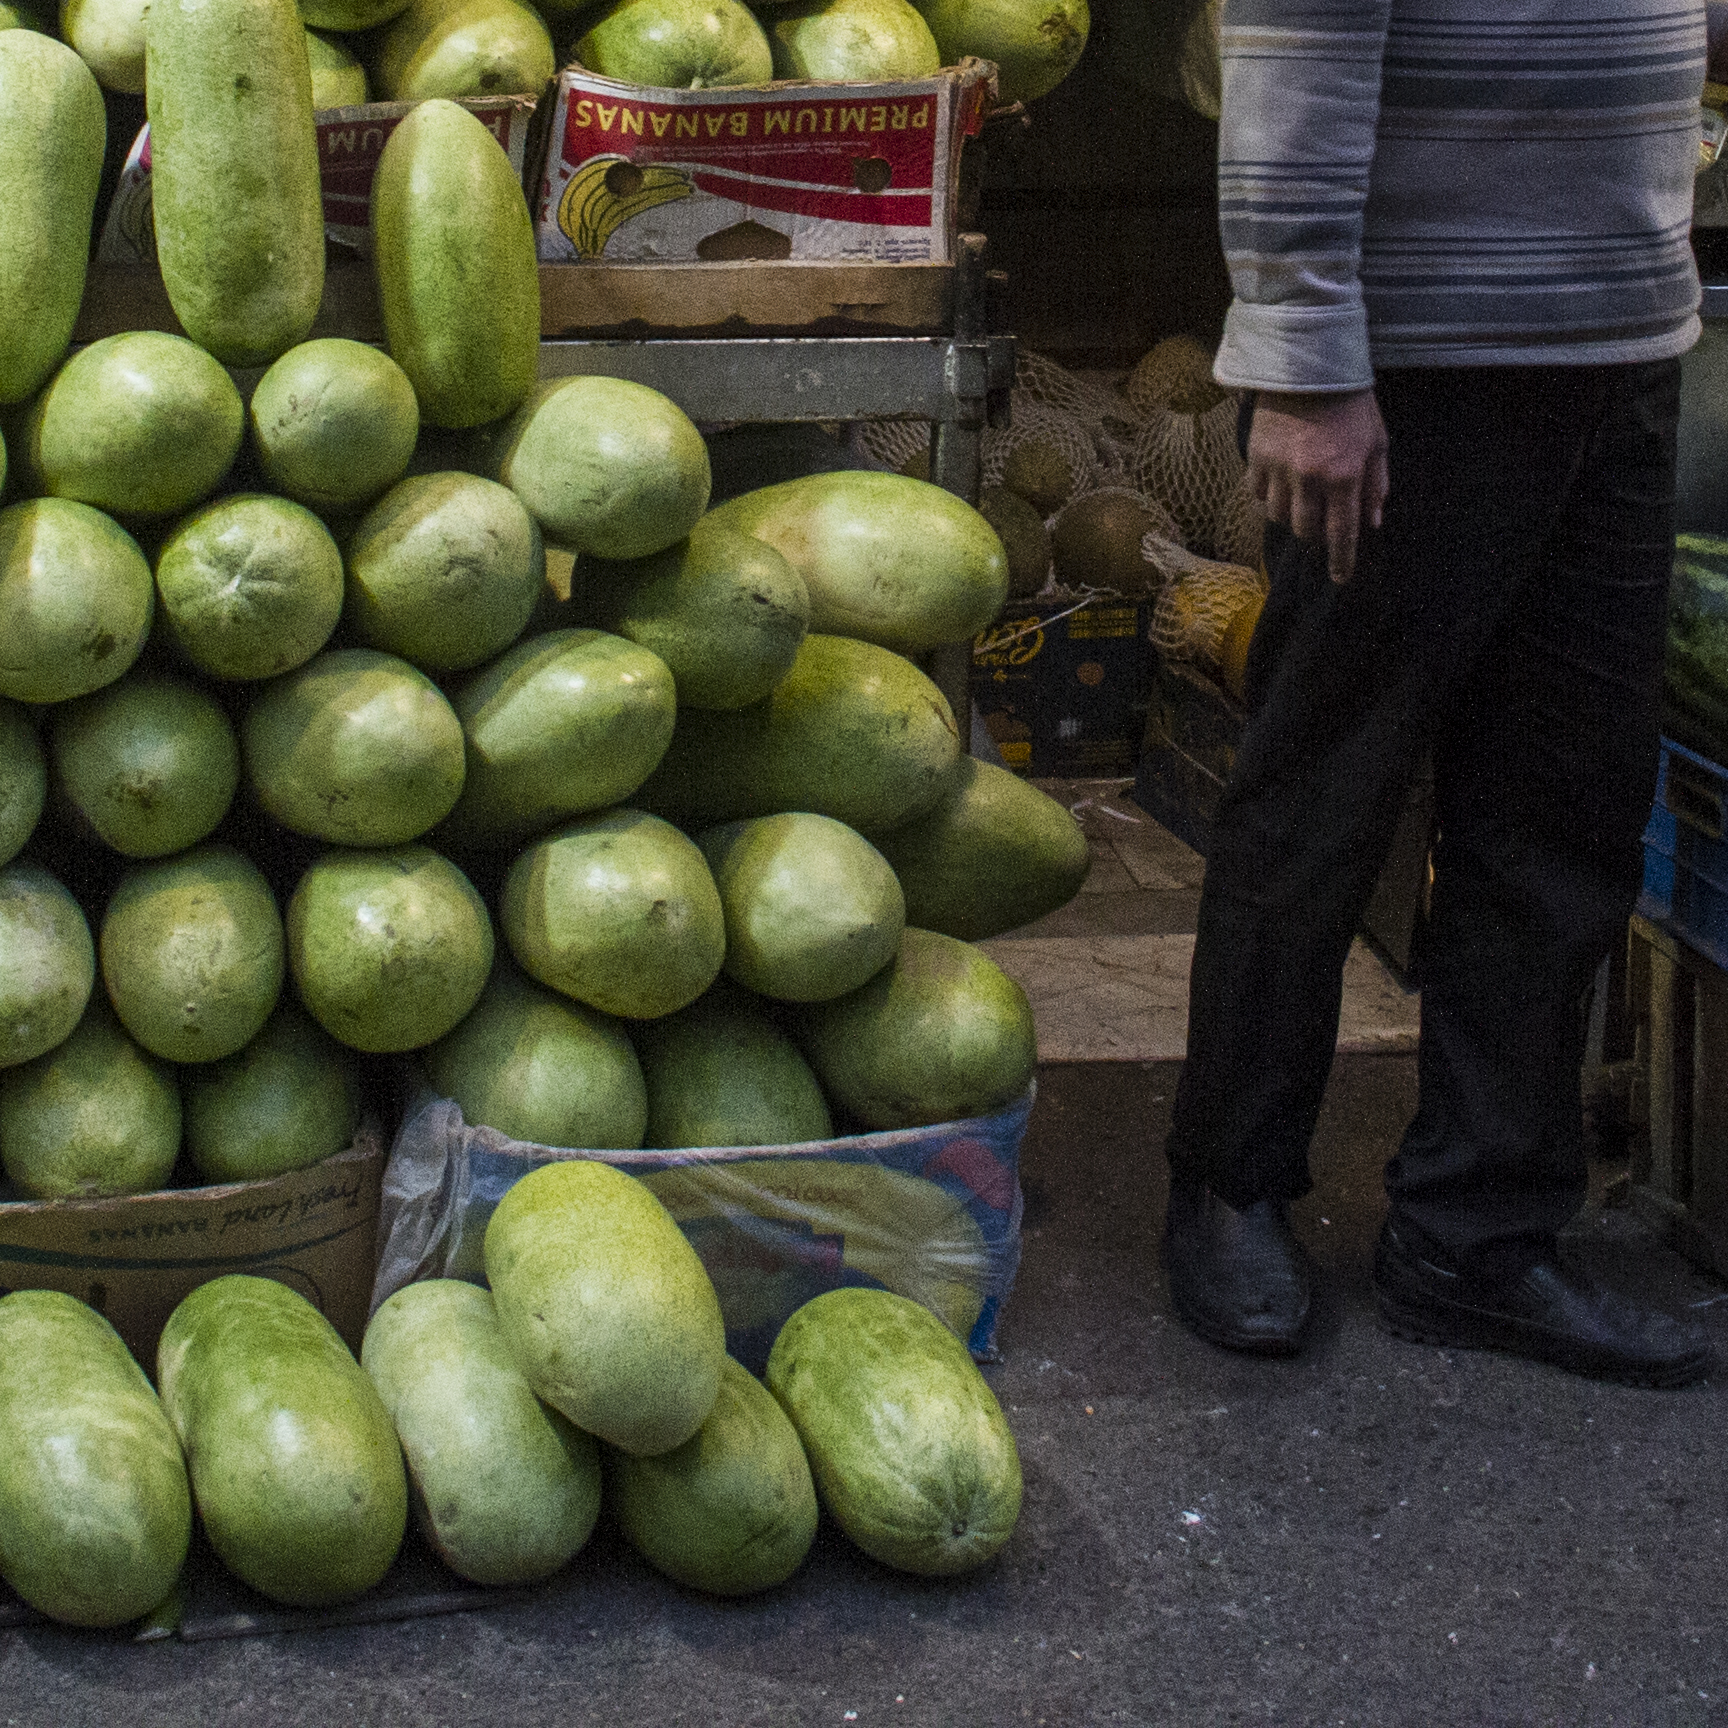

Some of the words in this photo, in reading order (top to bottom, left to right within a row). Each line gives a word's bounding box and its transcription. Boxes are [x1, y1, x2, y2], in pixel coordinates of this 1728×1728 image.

[574, 98, 747, 139] BANANAS
[764, 98, 930, 136] PREMIUM
[87, 1217, 209, 1244] BANANAS
